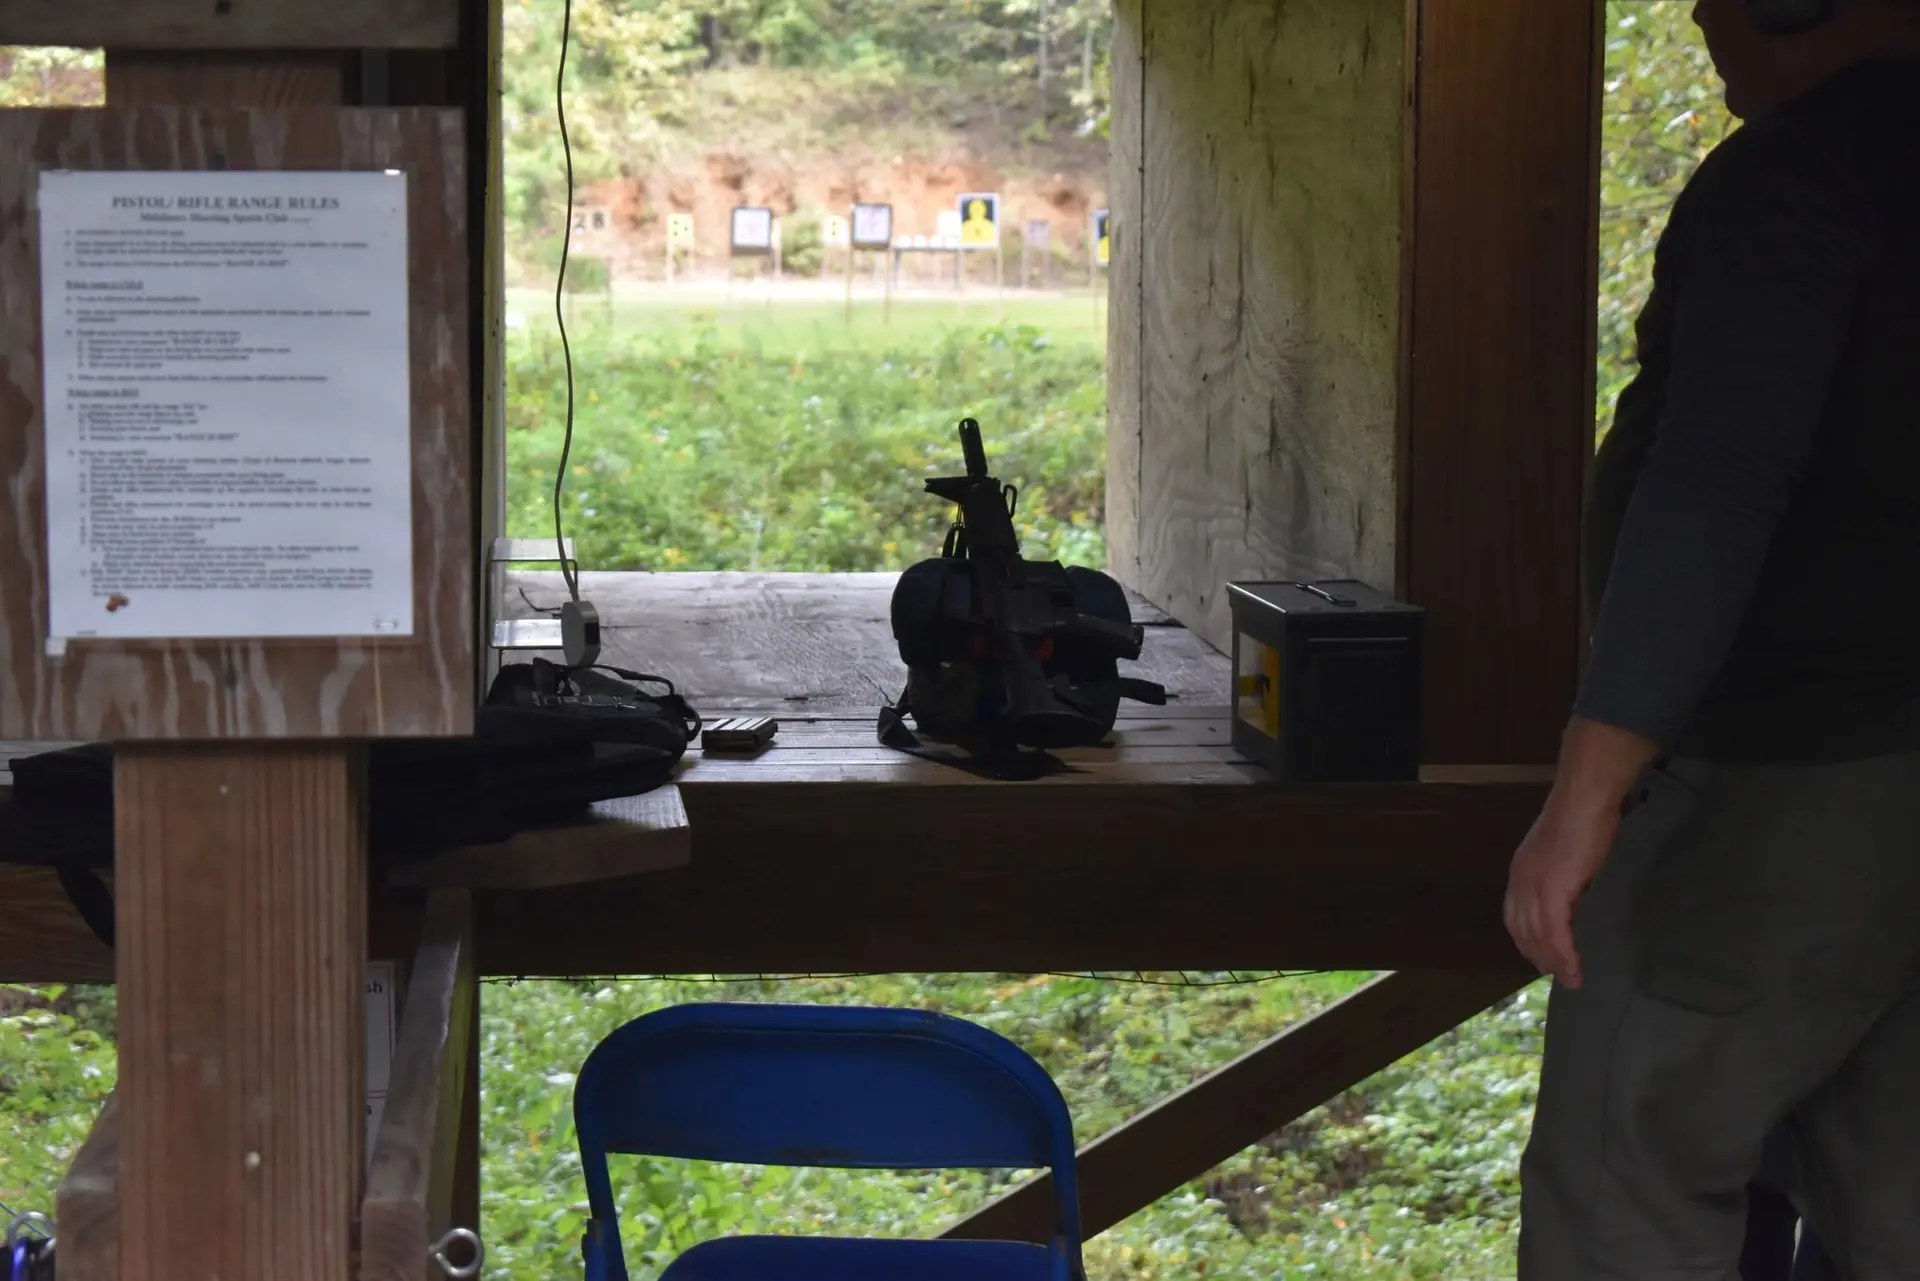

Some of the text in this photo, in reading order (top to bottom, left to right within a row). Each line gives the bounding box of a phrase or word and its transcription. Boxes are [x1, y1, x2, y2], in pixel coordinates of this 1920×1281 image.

[177, 195, 223, 209] RIFLE
[228, 195, 282, 209] RANGE
[288, 195, 339, 209] RULES
